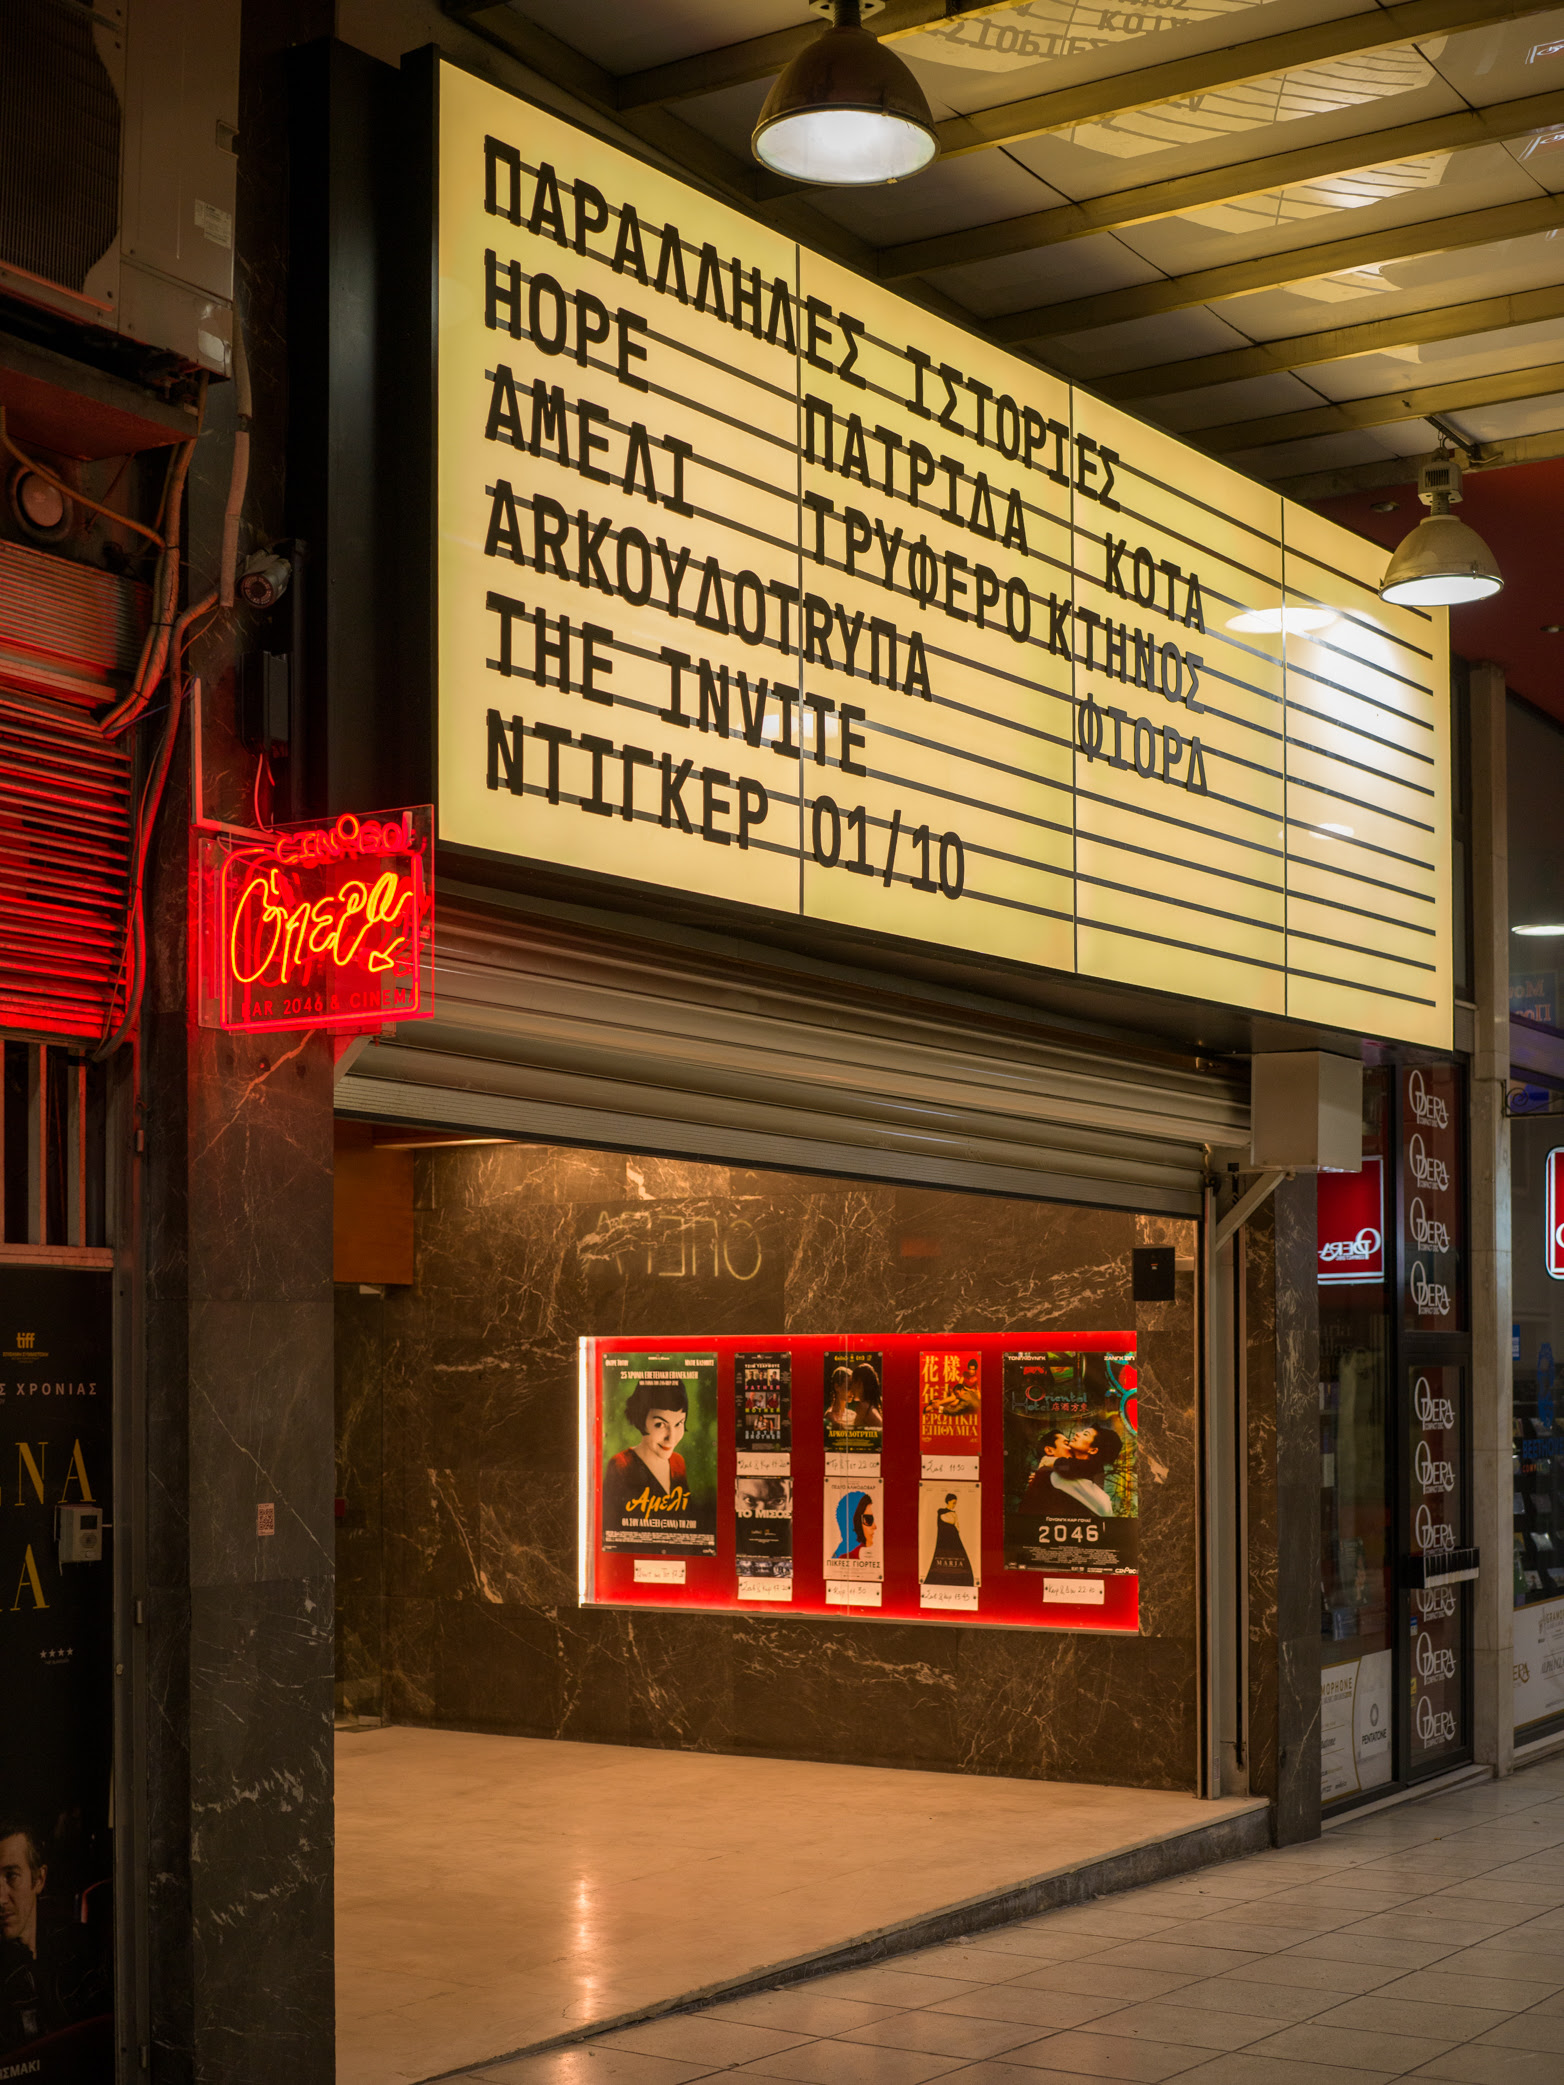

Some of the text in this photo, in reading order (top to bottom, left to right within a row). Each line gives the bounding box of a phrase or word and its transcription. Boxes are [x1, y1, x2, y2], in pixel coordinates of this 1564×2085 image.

[484, 248, 649, 393] HOPE
[484, 134, 1121, 512] ΠΑΡΑΛΛΗΛΕΣ ΙΣΤΟΡΙΕΣ
[484, 364, 693, 518] ΑΜΕΛΙ
[805, 393, 1029, 557] ΠΑΤΡΙΔΑ
[804, 490, 1205, 714] ΤΡΥΦΕΡΟ ΚΤΗΝΟΣ
[1105, 532, 1206, 635] ΚΟΤΑ
[486, 591, 867, 778] THE INVITE
[1078, 693, 1208, 797] ΦΙΟΡΔ
[487, 708, 965, 900] ΝΤΙΓΚΕΡ 01/10
[283, 996, 324, 1015] 2046
[1409, 1069, 1449, 1129] OPERA
[1410, 1133, 1450, 1192] OPERA
[1410, 1197, 1450, 1254] OPERA
[1411, 1260, 1451, 1316] OPERA
[16, 1332, 35, 1349] tiff
[16, 1382, 97, 1396] ΧΡΟΝΙΑΣ
[1414, 1376, 1455, 1431] OPERA
[922, 1413, 978, 1425] ΕΡΩΤΙΚΗ
[922, 1425, 979, 1437] ΕΠΙΘΥΜΙΑ
[1415, 1440, 1456, 1495] OPERA
[625, 1486, 691, 1521] Αμελί
[1039, 1525, 1099, 1543] 2046
[827, 1560, 880, 1569] ΠΙΚΡΕΣ ΓΙΟΡΤΕΣ
[1416, 1631, 1457, 1686] OPERA
[1416, 1695, 1457, 1749] OPERA
